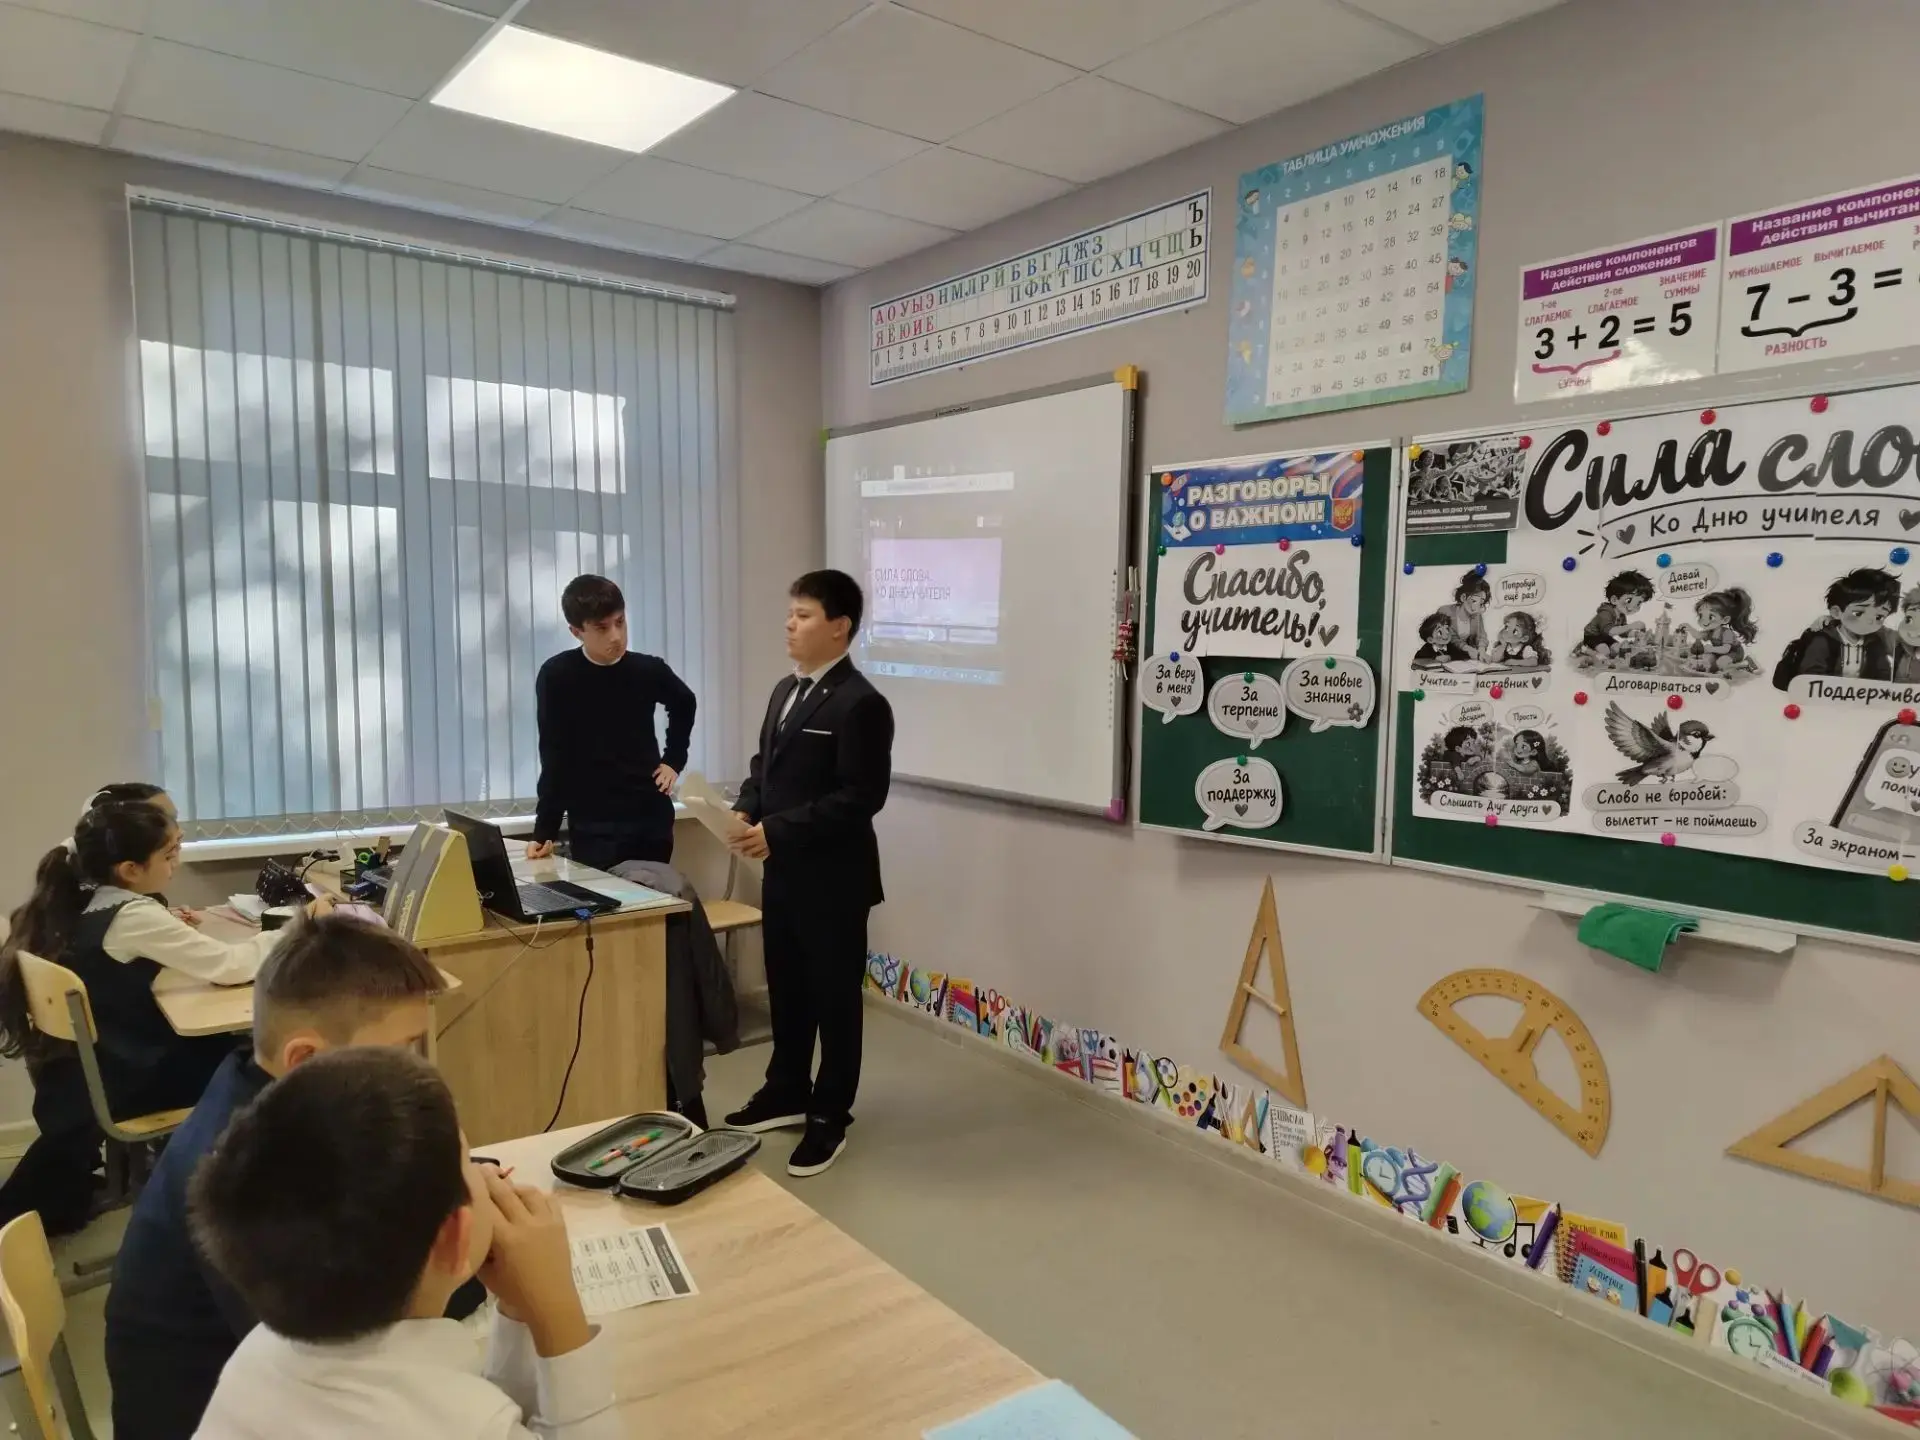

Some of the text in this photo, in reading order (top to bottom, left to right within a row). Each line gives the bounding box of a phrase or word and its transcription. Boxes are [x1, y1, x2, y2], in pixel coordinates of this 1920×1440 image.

[1282, 116, 1426, 176] ТАБЛИЦА УМНОЖЕНИЯ
[1752, 206, 1832, 233] Название
[1761, 200, 1920, 247] действия вычитан
[875, 310, 884, 325] А
[888, 305, 896, 321] О
[901, 301, 910, 317] У
[912, 296, 923, 314] Ы
[926, 293, 934, 309] Э
[939, 288, 948, 305] Н
[951, 283, 963, 300] М
[965, 277, 977, 297] Л
[980, 274, 989, 292] Р
[1011, 263, 1020, 281] Б
[1027, 258, 1037, 276] В
[1043, 252, 1052, 271] Г
[1058, 245, 1070, 270] Д
[1074, 239, 1089, 262] Ж
[1189, 200, 1203, 224] Ъ
[1540, 238, 1697, 280] Название компонентов
[1728, 256, 1803, 280] УМЕНЬШАЕМОЕ
[1814, 240, 1886, 262] ВЫЧИТАЕМОЕ
[1552, 255, 1681, 291] действия сложения
[1659, 268, 1707, 287] ЗНАЧЕНИЕ
[876, 330, 884, 347] Я
[900, 322, 911, 339] Ю
[1009, 285, 1021, 304] П
[1025, 279, 1039, 298] Ф
[1041, 274, 1052, 294] К
[1059, 268, 1069, 288] Т
[1073, 262, 1089, 284] Ш
[1129, 245, 1143, 268] Ц
[1149, 239, 1161, 259] Ч
[1189, 228, 1203, 248] Ь
[1007, 312, 1017, 330] 10
[1024, 308, 1032, 326] 11
[1038, 303, 1048, 321] 12
[1056, 298, 1066, 316] 13
[1072, 293, 1083, 311] 14
[1091, 288, 1101, 306] 15
[1109, 282, 1120, 301] 16
[1129, 277, 1140, 297] 17
[1147, 271, 1159, 291] 18
[1167, 265, 1179, 285] 19
[1187, 258, 1201, 279] 20
[1664, 284, 1700, 299] СУММЫ
[1746, 283, 1771, 320] 7
[1828, 268, 1856, 306] 3
[1588, 296, 1639, 314] СЛАГАЕМОЕ
[1524, 309, 1573, 327] СЛАГАЕМОЕ
[1534, 327, 1554, 360] 3
[1599, 315, 1620, 349] 2
[1669, 301, 1692, 336] 5
[1765, 337, 1827, 356] РАЗНОСТЬ
[1525, 425, 1920, 531] Сила сло
[1186, 473, 1330, 506] РАЗГОВОРЫ
[1189, 500, 1326, 531] О ВАЖНОМ!
[1651, 506, 1881, 537] Ко Дню учителя
[1183, 550, 1327, 610] Спасибо,
[1502, 579, 1536, 591] Попробуй
[1668, 568, 1701, 584] Давай
[1521, 589, 1538, 602] раз!
[1670, 579, 1708, 594] вместе!
[1181, 605, 1321, 652] учитель!
[1156, 664, 1196, 684] За веру
[1300, 670, 1363, 688] За новые
[1419, 673, 1458, 686] Учитель
[1156, 682, 1192, 695] в меня
[1241, 686, 1258, 702] За
[1304, 690, 1351, 704] знания
[1222, 704, 1279, 721] терпение
[1233, 769, 1250, 785] За
[1207, 787, 1276, 807] поддержку
[1440, 794, 1539, 817] Слышать Дуг друга
[1597, 789, 1639, 804] Слово
[1645, 791, 1662, 803] не
[1605, 814, 1758, 828] вылетит не поймаешь
[1803, 828, 1899, 861] За экраном
